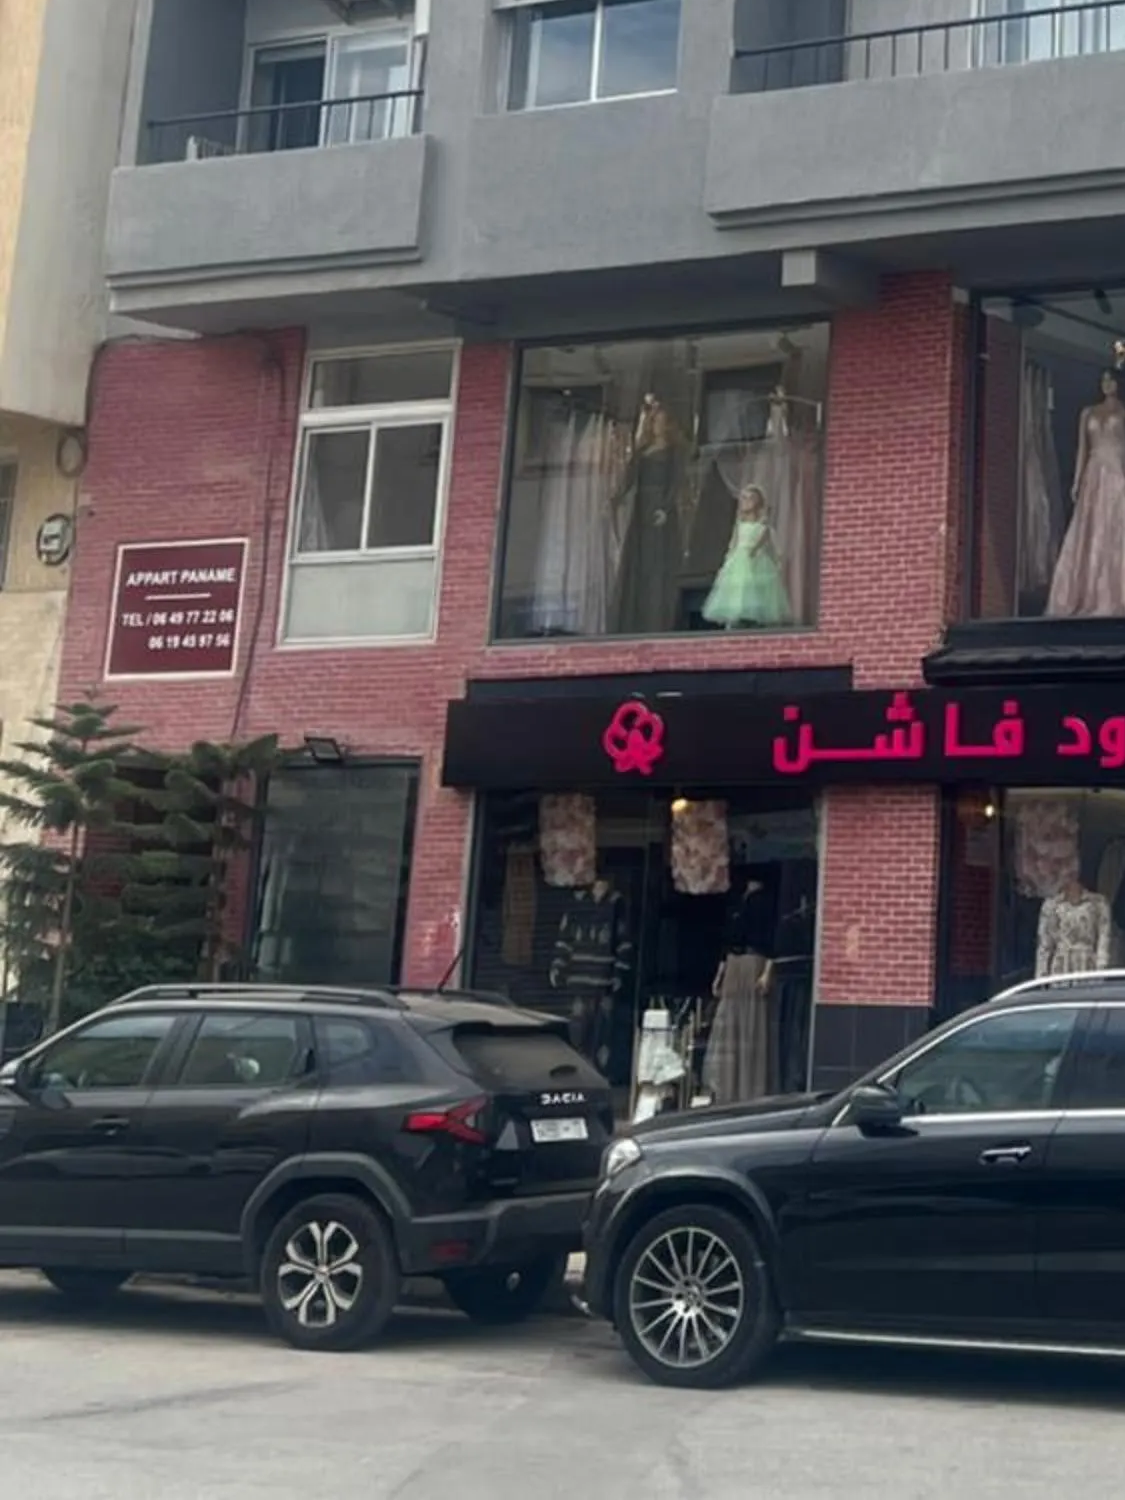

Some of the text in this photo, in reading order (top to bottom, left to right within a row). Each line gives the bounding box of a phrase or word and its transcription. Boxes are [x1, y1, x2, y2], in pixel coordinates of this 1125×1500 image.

[126, 567, 237, 587] APPART PANAME
[122, 613, 144, 627] TEL
[169, 611, 184, 625] 49
[186, 610, 200, 625] 77
[202, 609, 216, 624] 22
[219, 608, 234, 623] 06
[772, 691, 1024, 773] فاشن
[540, 1092, 585, 1105] DACIA
